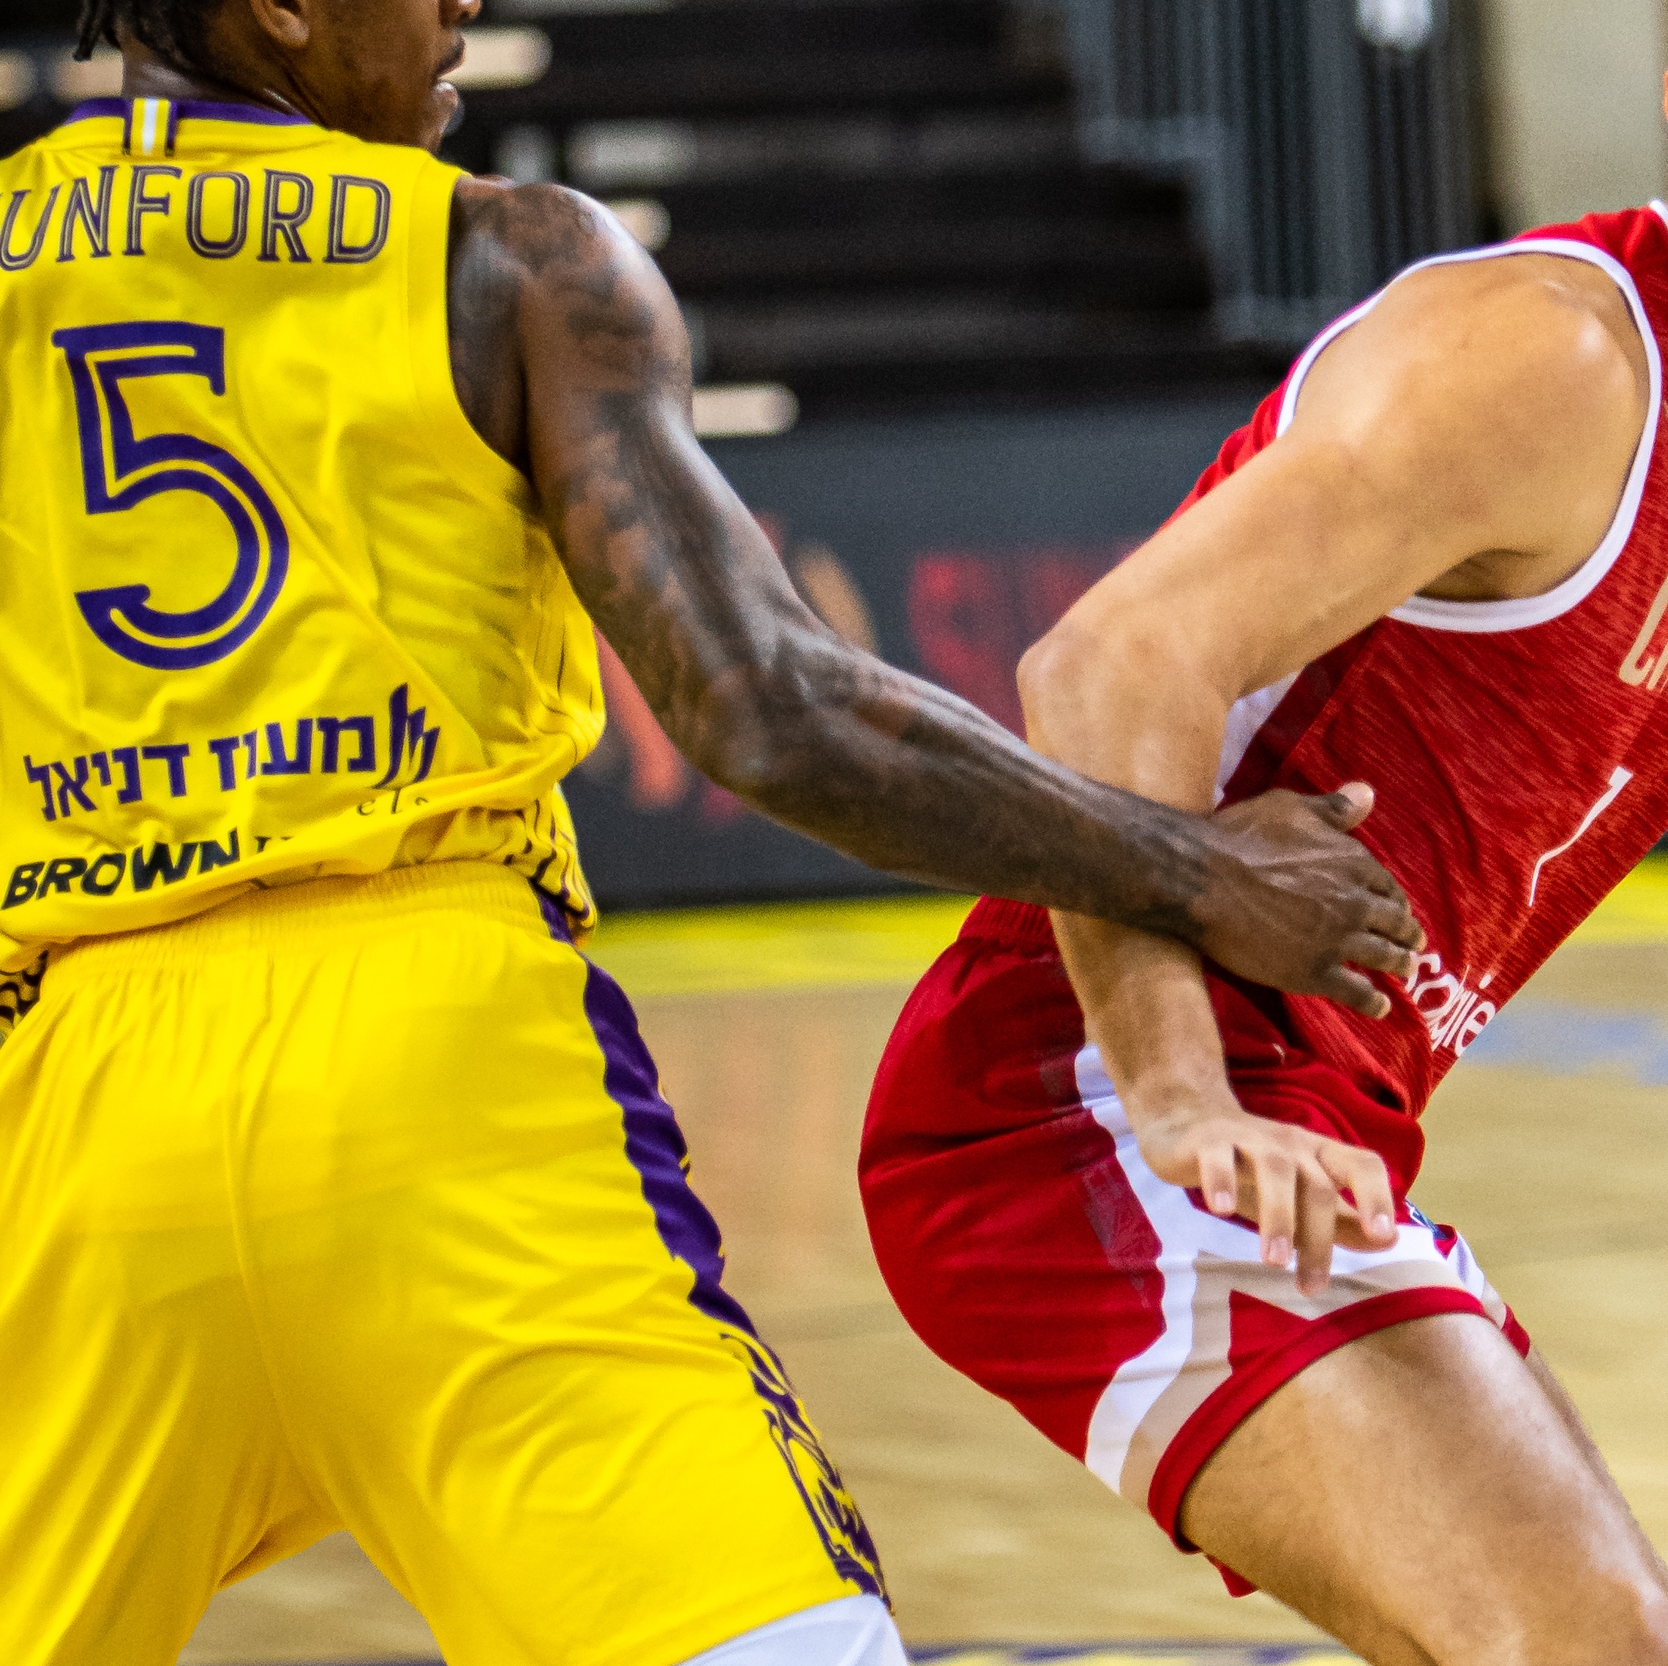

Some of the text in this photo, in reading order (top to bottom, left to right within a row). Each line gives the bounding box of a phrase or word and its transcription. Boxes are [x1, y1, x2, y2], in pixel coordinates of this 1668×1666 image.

[53, 320, 290, 671] 5
[23, 742, 190, 822] דניאל
[208, 715, 376, 792] מעוז
[0, 826, 241, 911] BROWN
